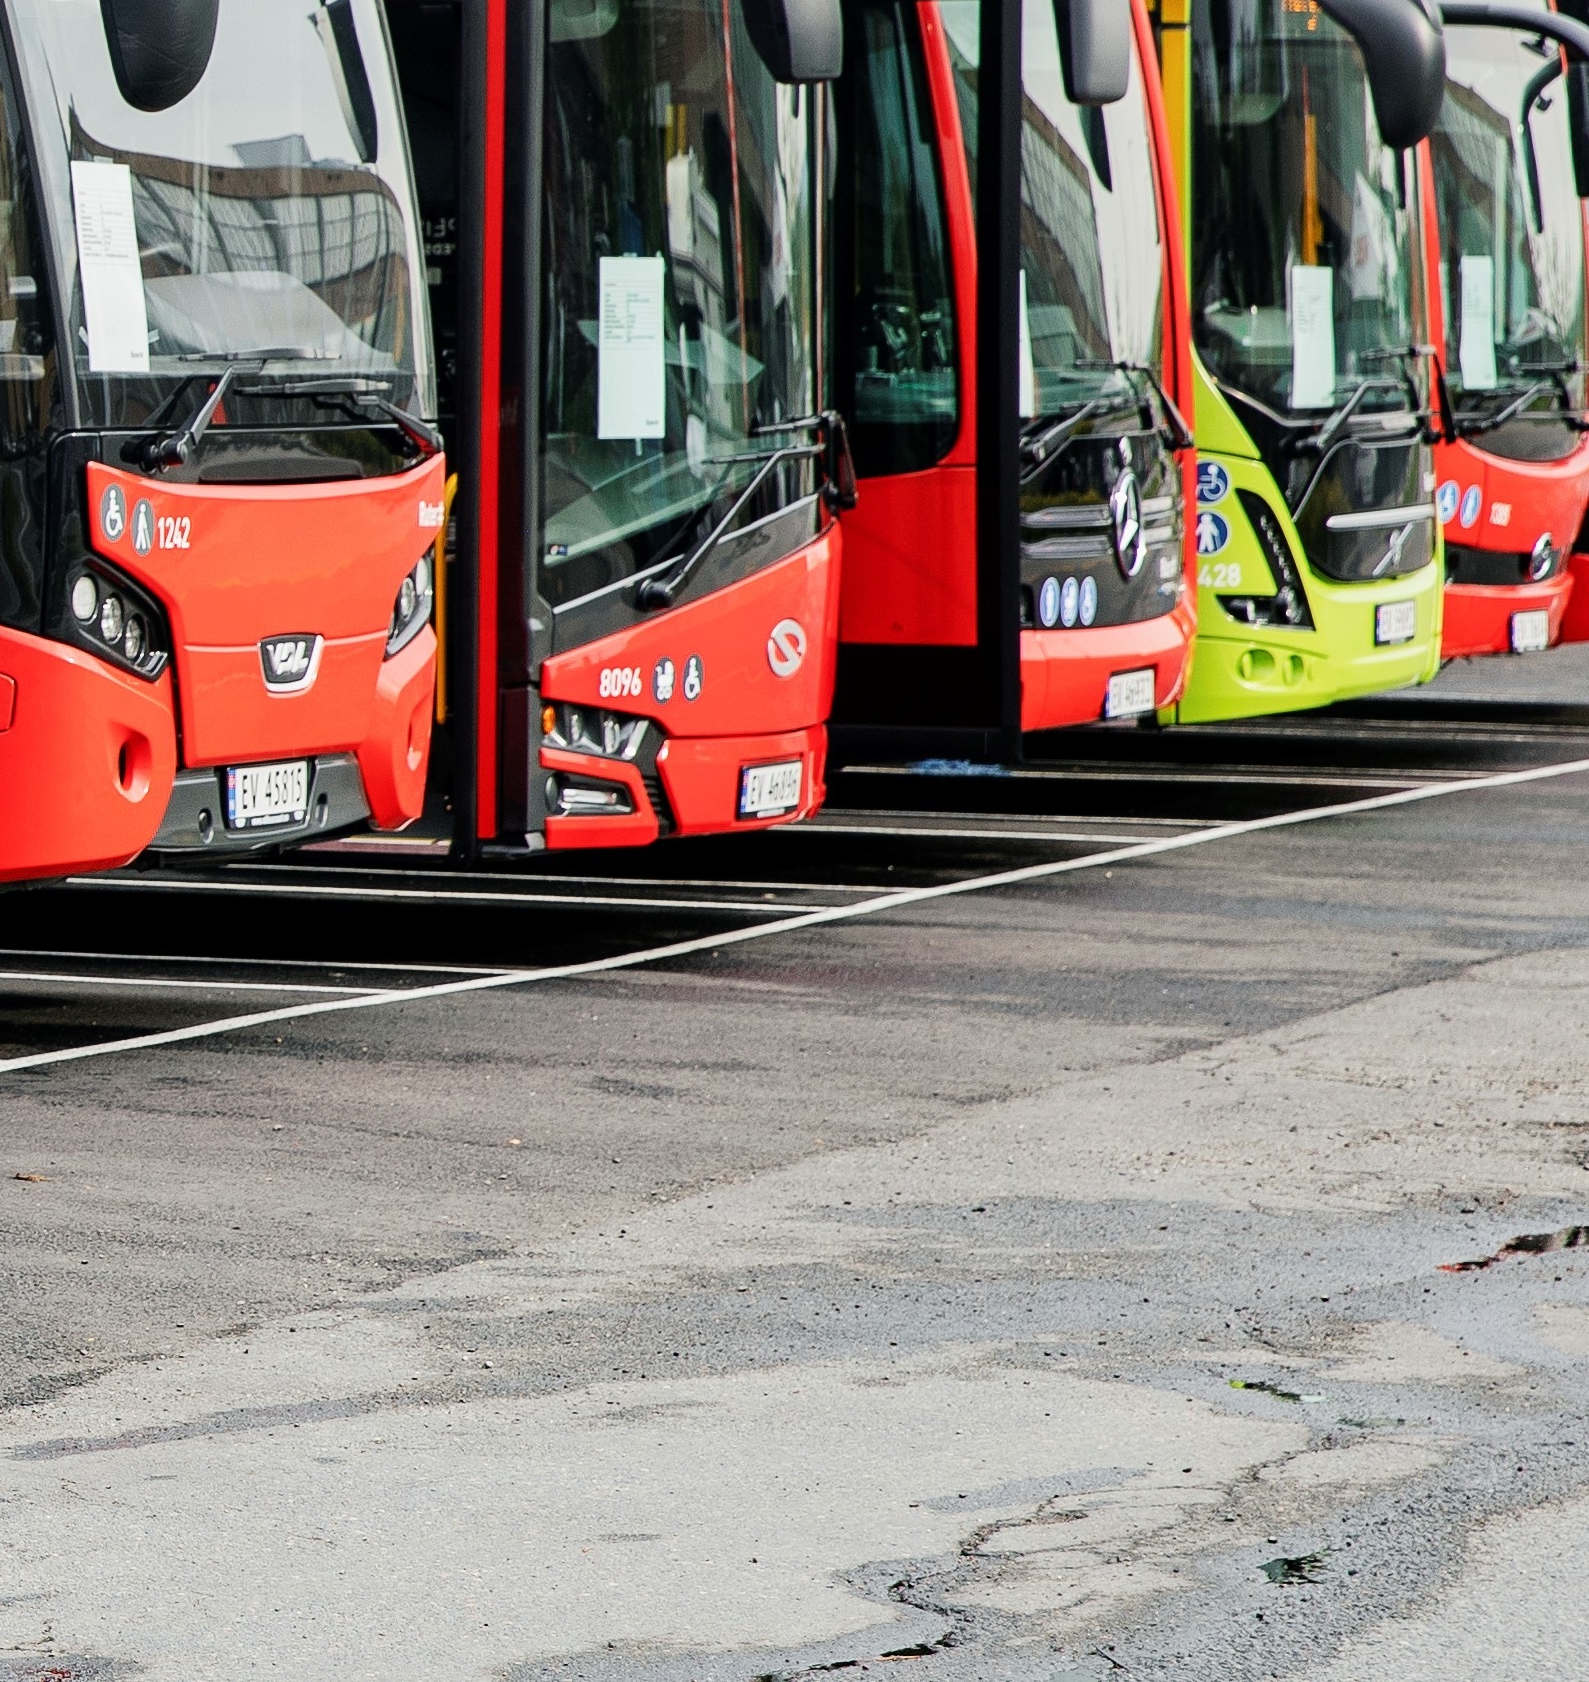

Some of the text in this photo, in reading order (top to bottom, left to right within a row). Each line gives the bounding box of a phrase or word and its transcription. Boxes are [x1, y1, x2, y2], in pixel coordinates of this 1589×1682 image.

[157, 515, 191, 551] 1242
[264, 640, 312, 675] VDL
[598, 666, 643, 698] 8096
[242, 768, 303, 810] EV 45815
